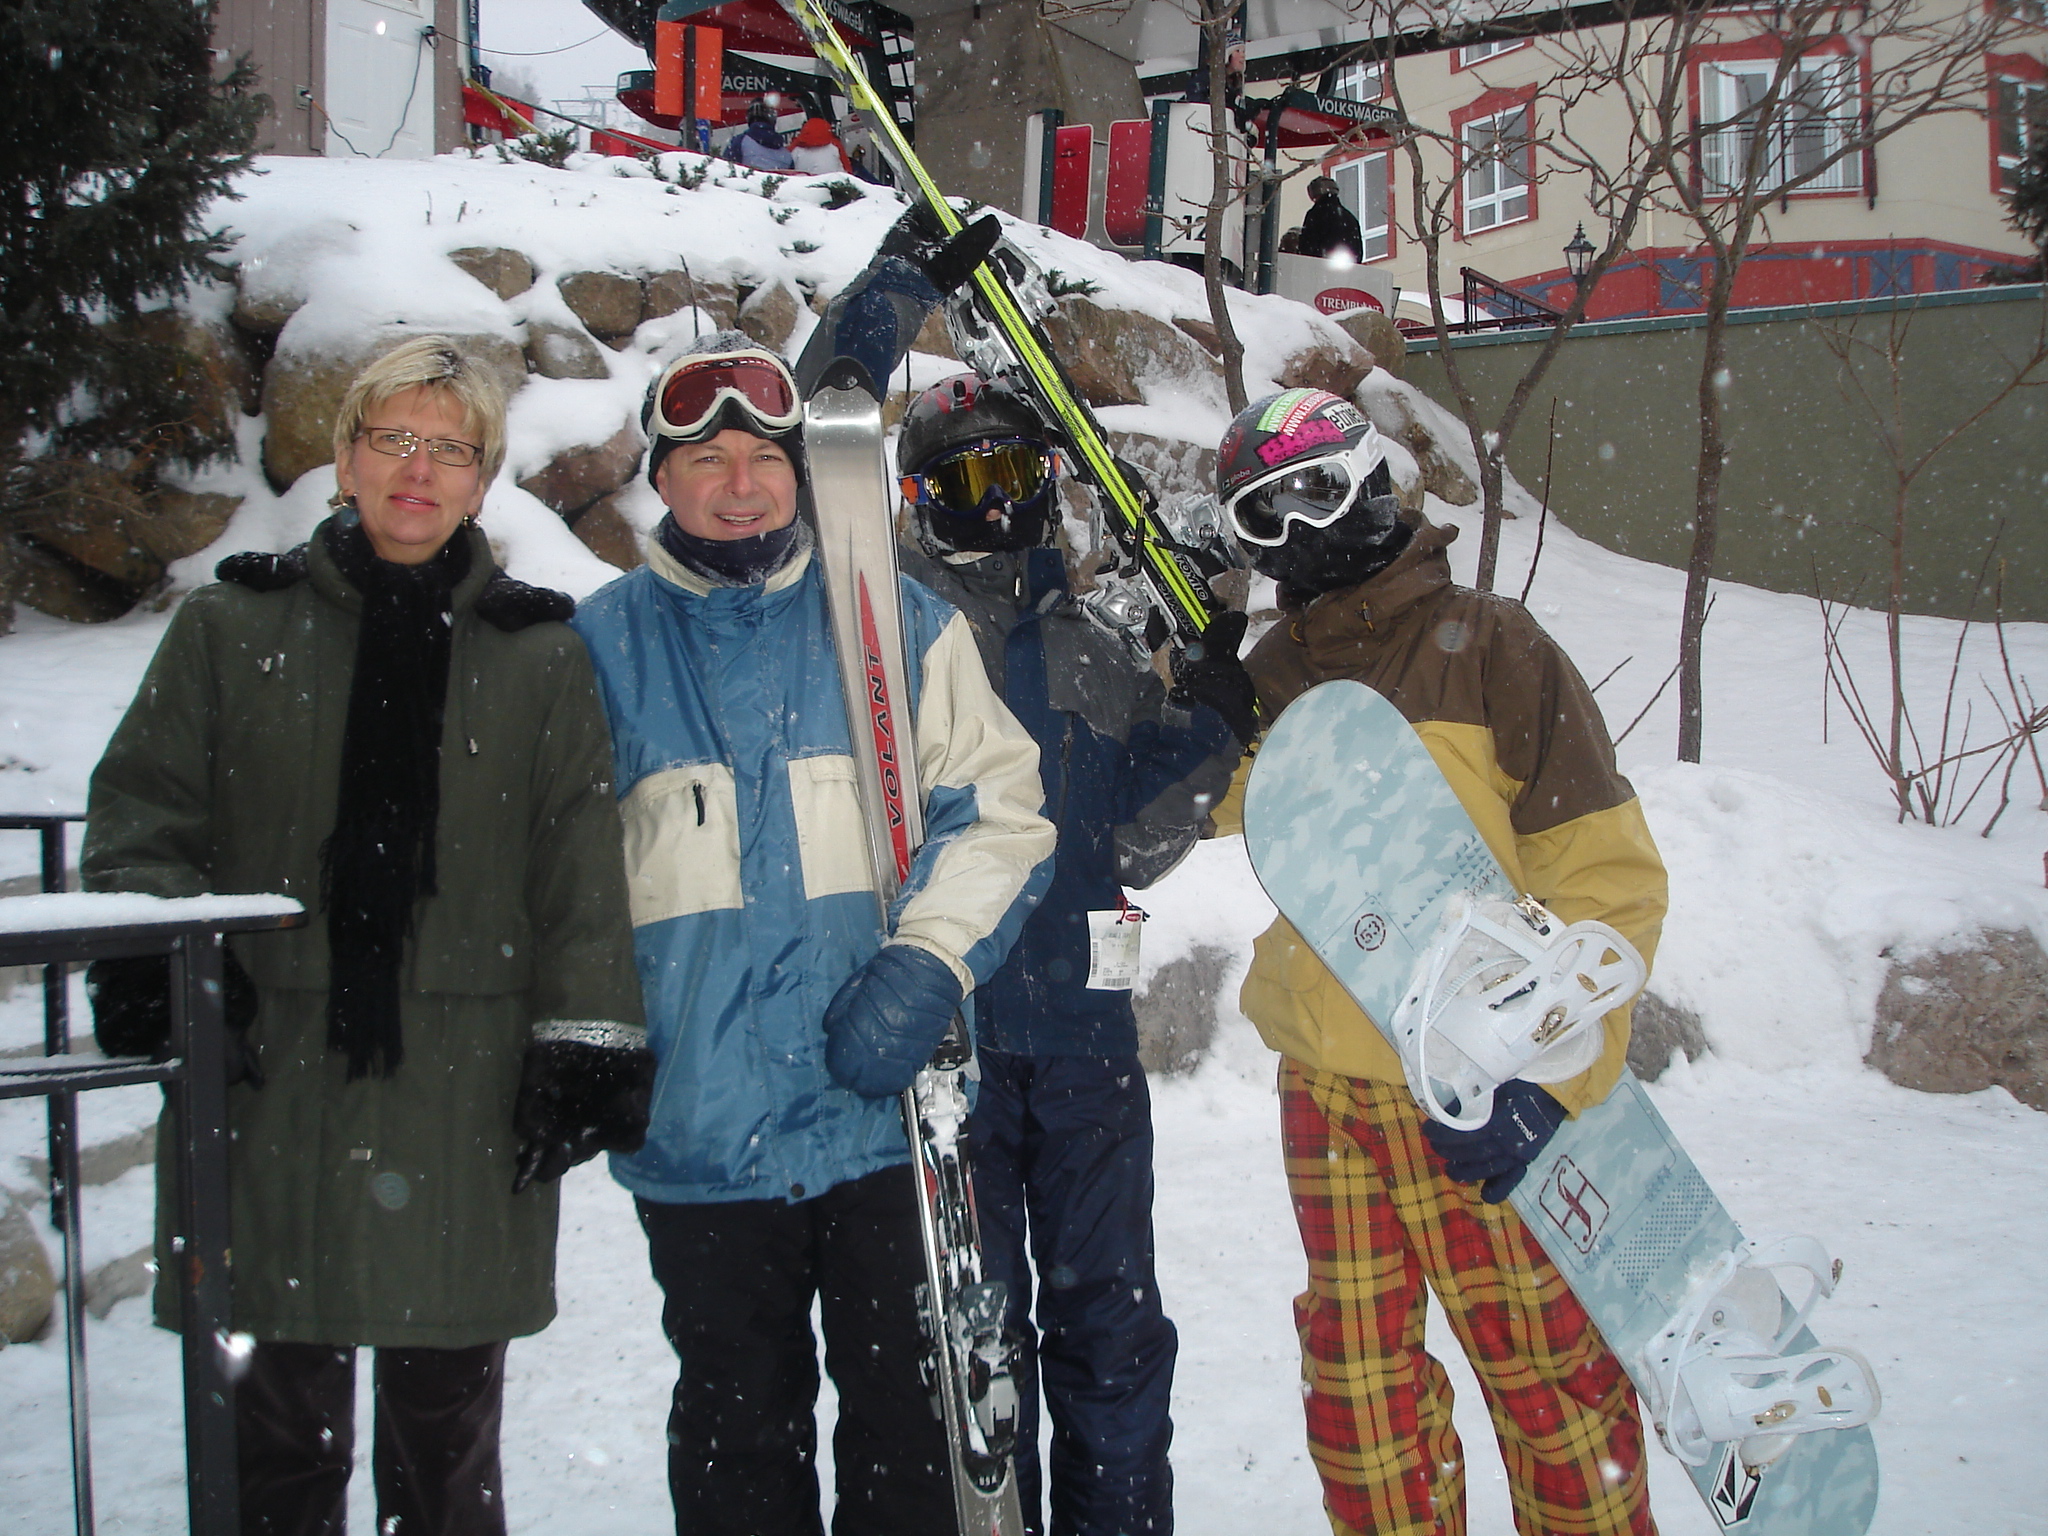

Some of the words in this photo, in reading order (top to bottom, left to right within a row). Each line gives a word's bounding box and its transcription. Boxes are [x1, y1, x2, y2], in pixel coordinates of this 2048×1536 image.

[721, 75, 767, 91] AGEN
[1316, 98, 1394, 122] VOLKSWAGEN
[1174, 553, 1209, 601] TOMIC
[865, 646, 904, 827] VOLANT
